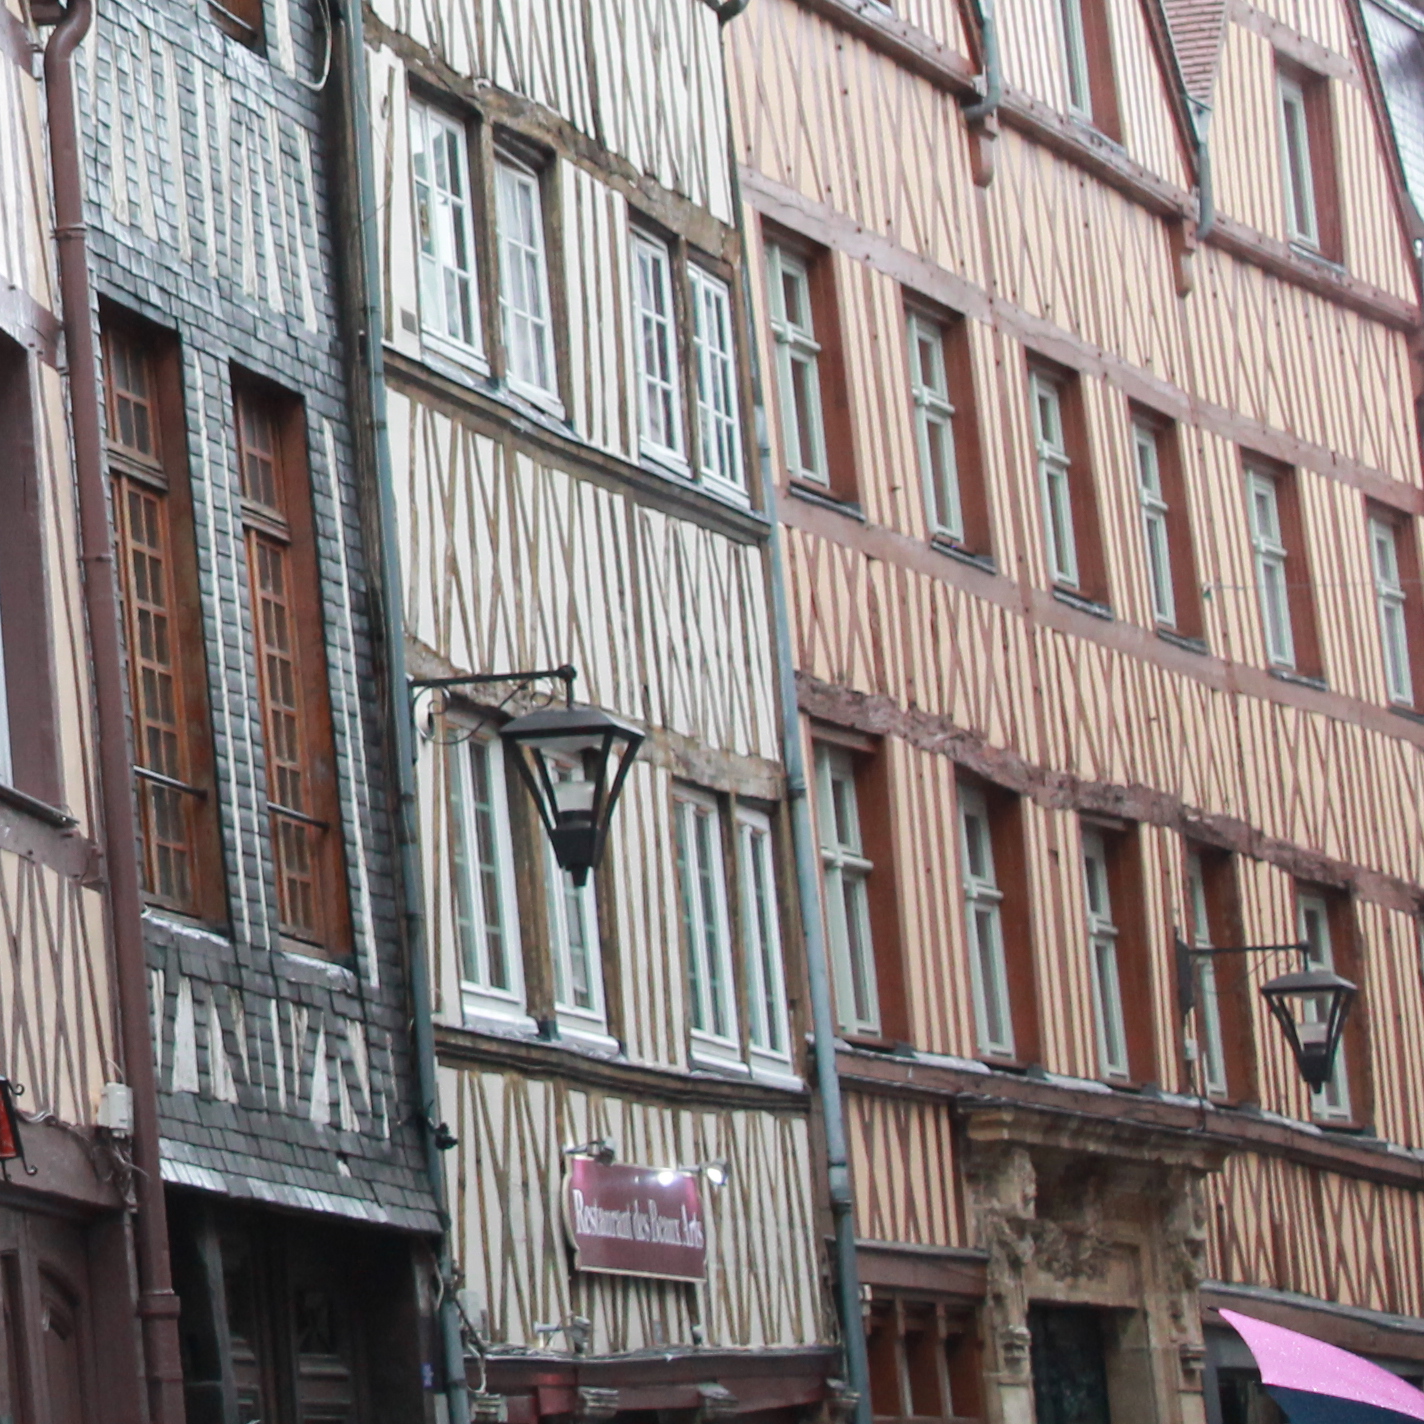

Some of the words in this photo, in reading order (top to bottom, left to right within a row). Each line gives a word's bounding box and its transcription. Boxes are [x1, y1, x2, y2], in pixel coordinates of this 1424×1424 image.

[572, 1189, 634, 1239] Restaurant
[633, 1199, 650, 1242] des
[648, 1198, 682, 1244] Beaux
[681, 1203, 704, 1249] Arts
